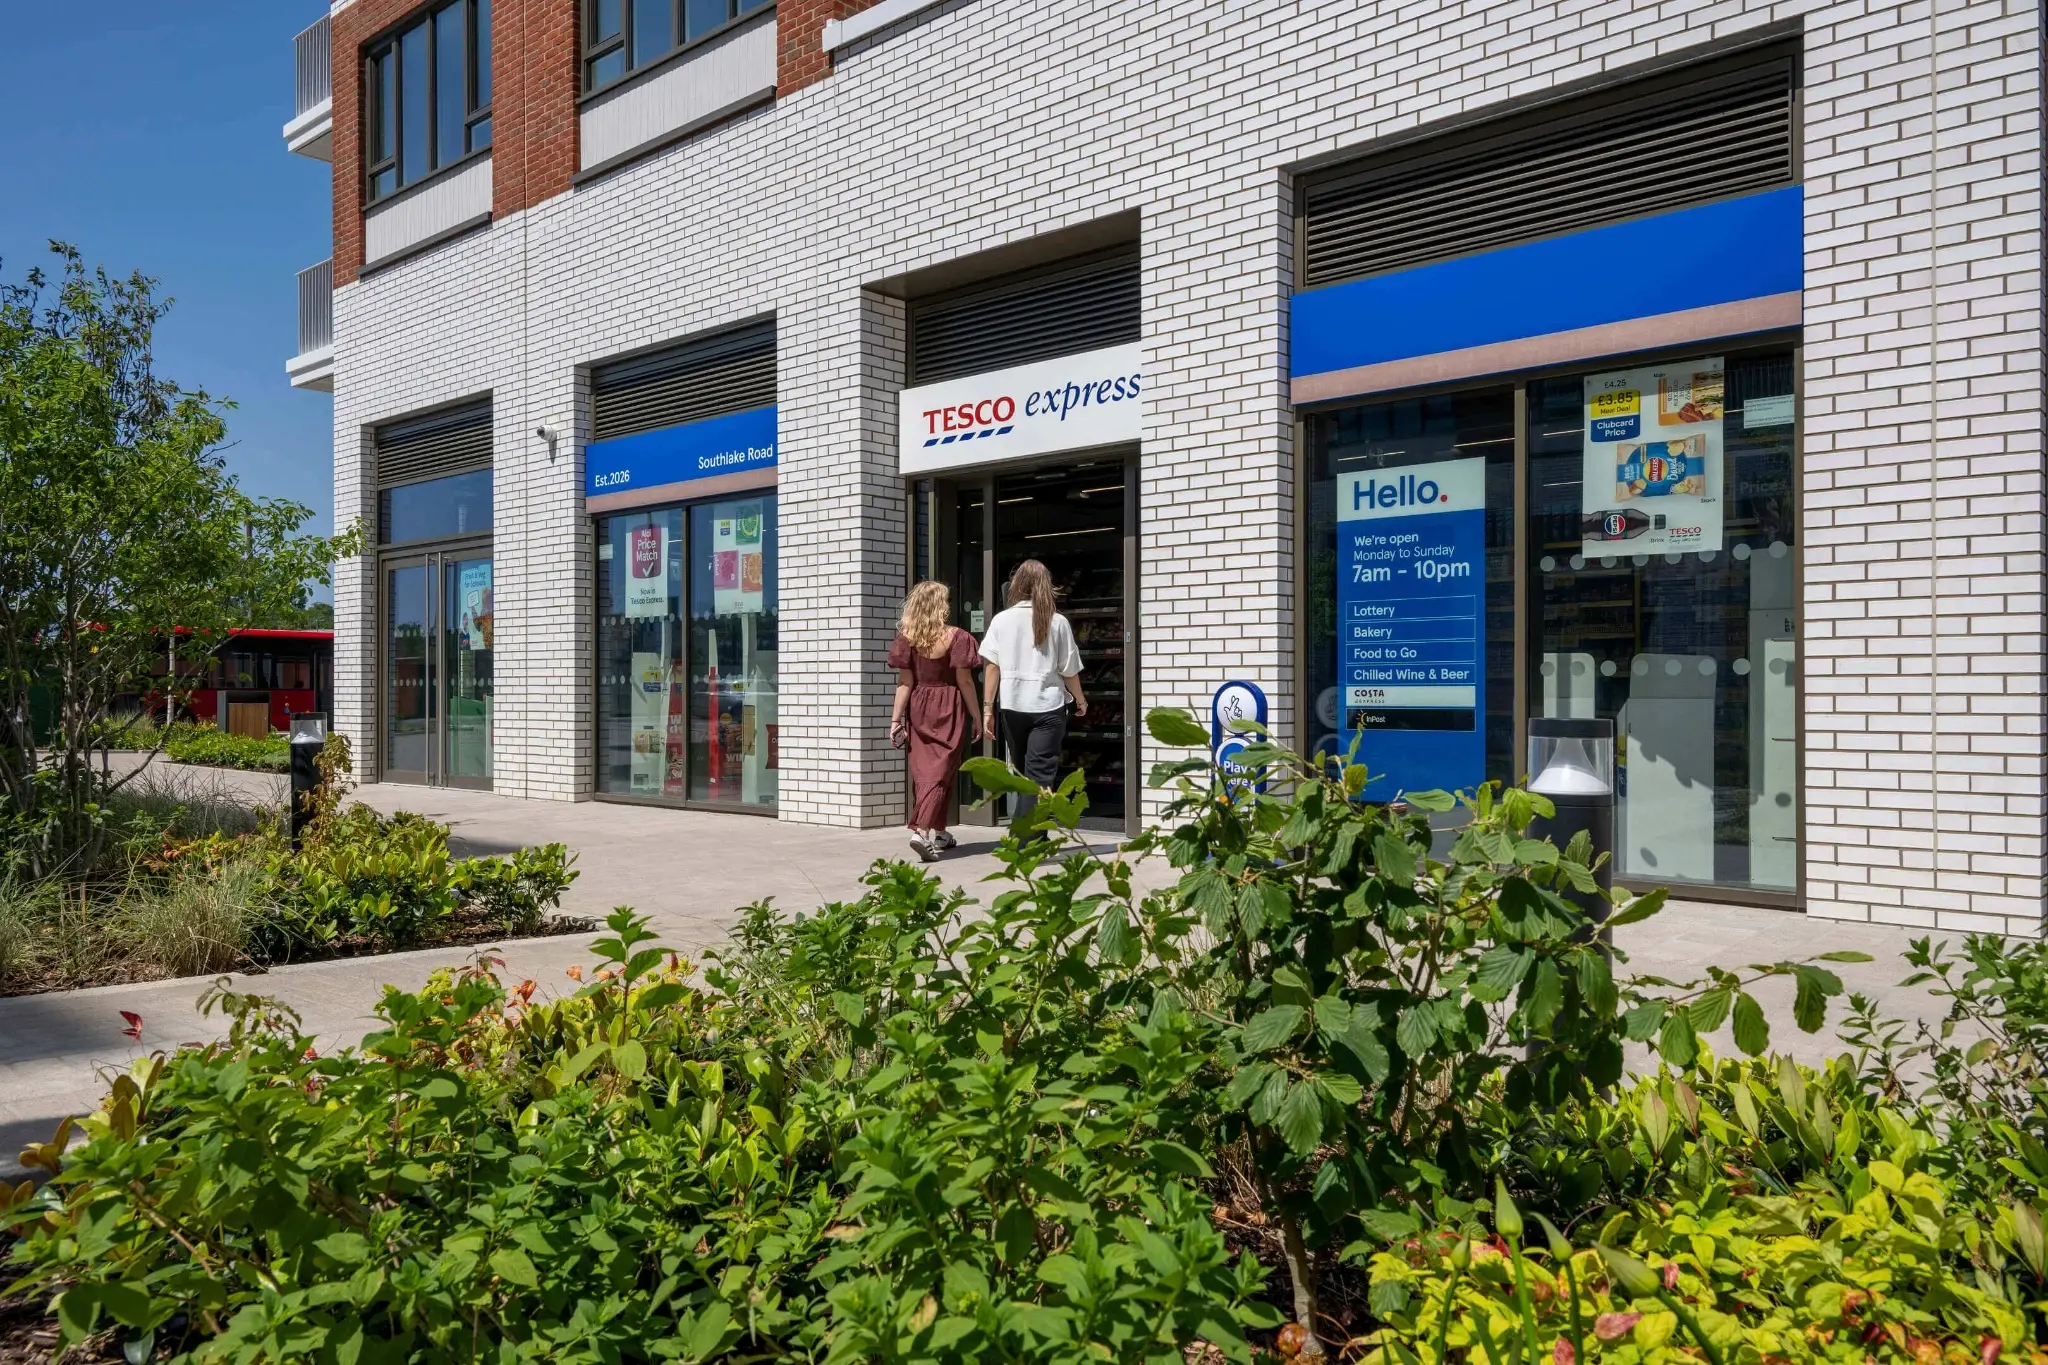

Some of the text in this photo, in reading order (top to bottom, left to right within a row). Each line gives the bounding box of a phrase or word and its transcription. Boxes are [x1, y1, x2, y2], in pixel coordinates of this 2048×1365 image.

[1604, 379, 1627, 389] £4.25
[923, 373, 1142, 435] TESCO express
[1597, 391, 1633, 407] £3.85
[1597, 418, 1634, 430] Clubcard
[1604, 429, 1626, 437] Price
[698, 444, 773, 470] Southlake Road
[595, 470, 631, 488] Est.2026
[1354, 475, 1448, 511] Hello.
[1669, 526, 1702, 535] TESCO
[637, 538, 657, 550] Price
[1354, 533, 1419, 547] We're open
[636, 550, 658, 562] Match
[1353, 544, 1455, 561] Monday to Sunday
[1352, 564, 1391, 583] 7am
[1414, 560, 1470, 583] 10pm
[1354, 606, 1395, 618] Lottery
[1354, 626, 1393, 639] Bakery
[1354, 647, 1417, 659] Food to Go
[1353, 668, 1470, 680] Chilled Wine & Beer
[1354, 689, 1385, 698] COSTA
[1366, 715, 1386, 723] InPost
